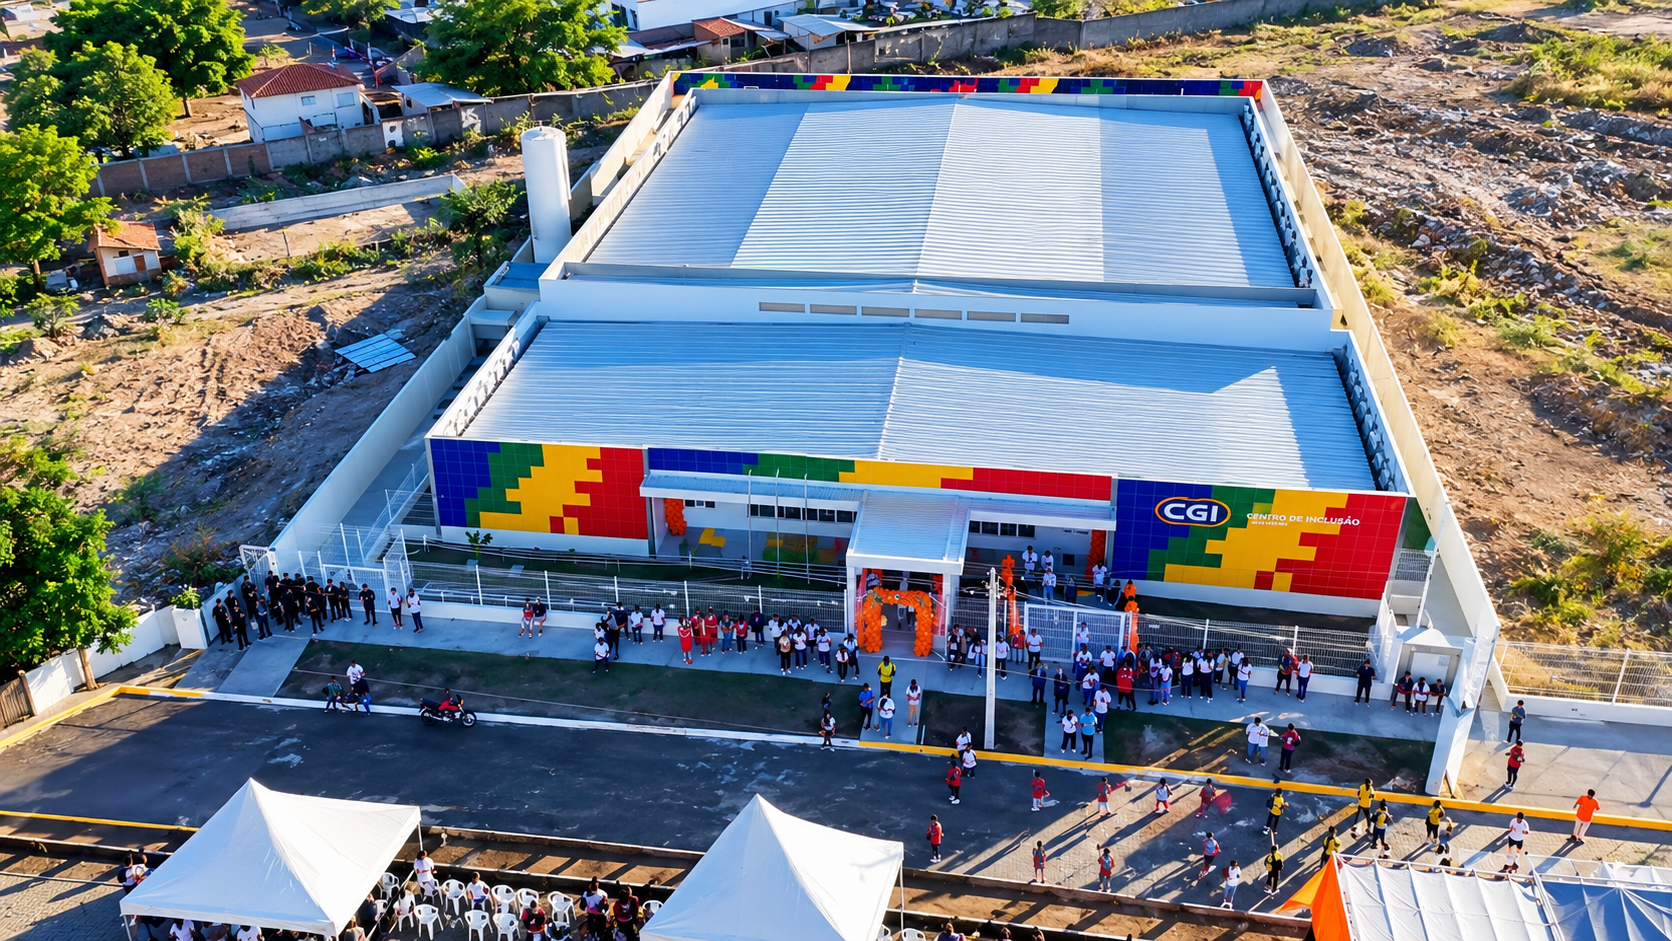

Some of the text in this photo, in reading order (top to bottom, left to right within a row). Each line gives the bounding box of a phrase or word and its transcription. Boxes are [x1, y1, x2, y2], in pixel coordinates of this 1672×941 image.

[1164, 503, 1218, 522] CGI
[1246, 512, 1287, 522] CENTRO
[1289, 515, 1304, 523] DE
